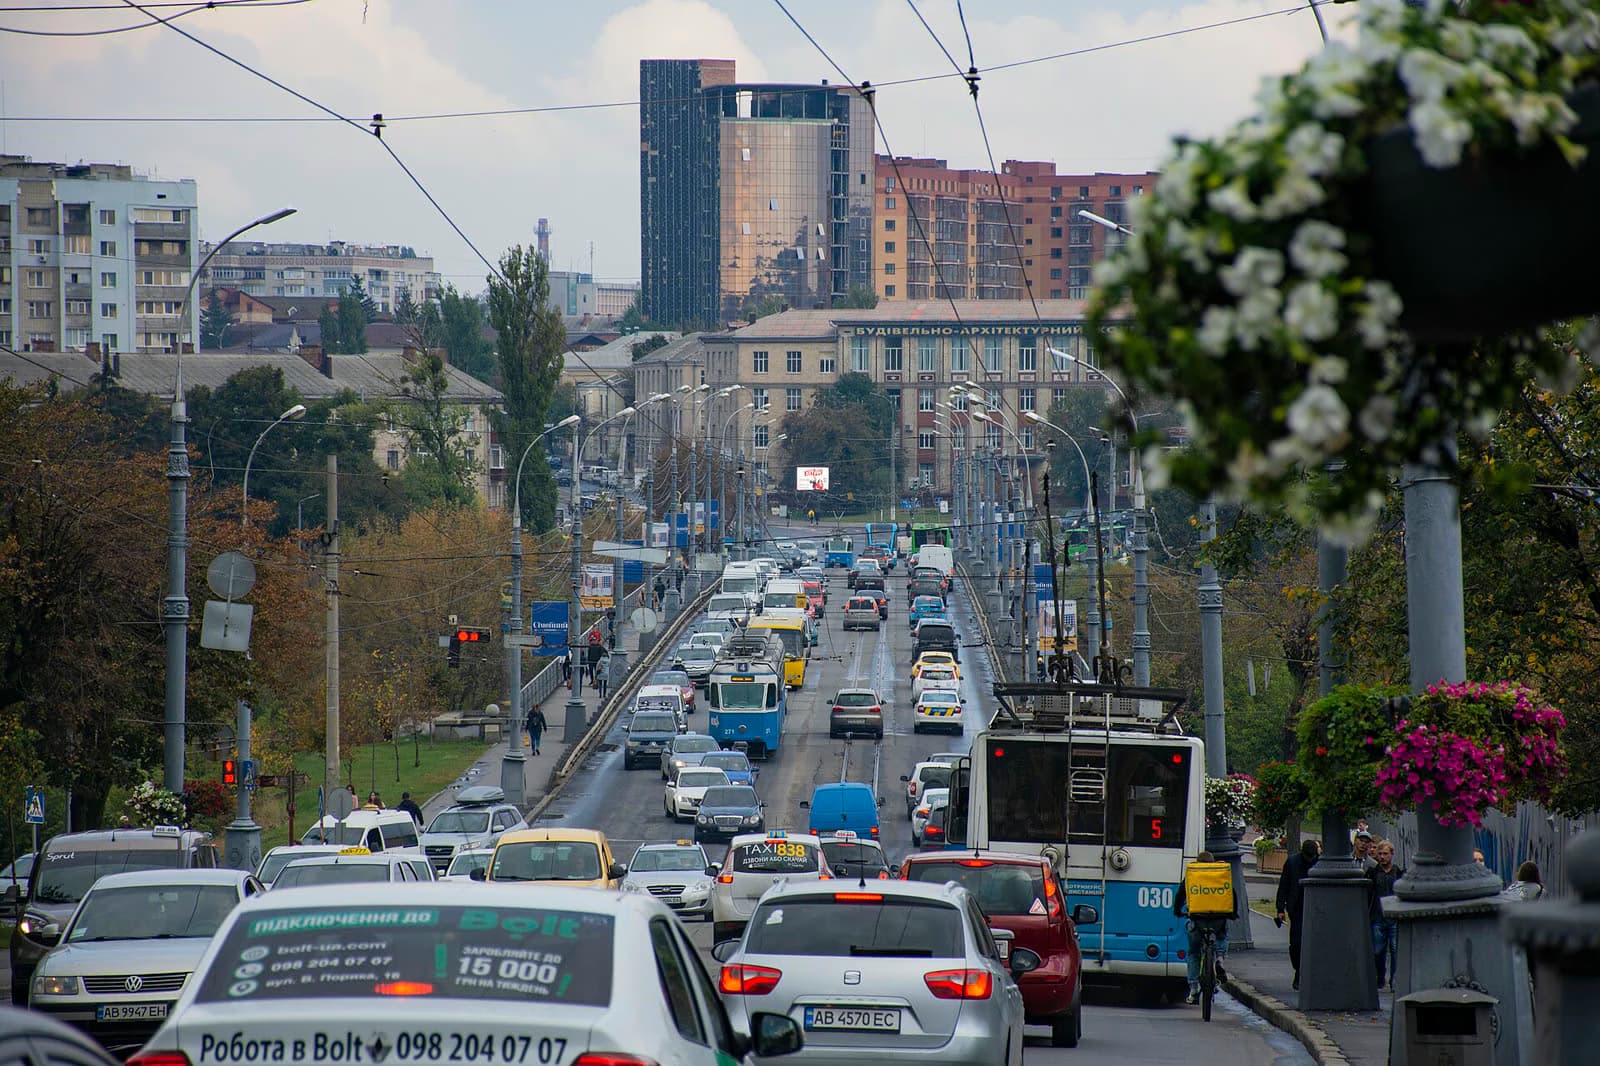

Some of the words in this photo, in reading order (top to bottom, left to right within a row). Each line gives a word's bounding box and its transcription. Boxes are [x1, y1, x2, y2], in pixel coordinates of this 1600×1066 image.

[1151, 819, 1162, 839] 5
[1138, 886, 1173, 908] 030
[254, 911, 398, 933] ПІДКЛЮЧЕННЯ
[402, 911, 432, 924] ДО
[459, 909, 580, 940] Bolt
[271, 960, 302, 972] 098
[307, 958, 339, 968] 204
[344, 956, 367, 967] 07
[371, 955, 393, 966] 07
[463, 946, 541, 961] ЗАРОБЛЯЙТЕ
[542, 953, 562, 965] ДО
[459, 956, 493, 977] 15
[498, 960, 558, 984] 000
[478, 979, 494, 988] НА
[496, 981, 550, 996] ТИЖДЕНЬ
[121, 1006, 147, 1018] 9947
[838, 1011, 870, 1026] 4570
[200, 1031, 285, 1062] Робота
[292, 1040, 306, 1062] в
[313, 1031, 363, 1062] Bolt
[396, 1031, 442, 1060] 098
[449, 1033, 495, 1062] 204
[502, 1035, 532, 1063] 07
[538, 1037, 568, 1065] 07
